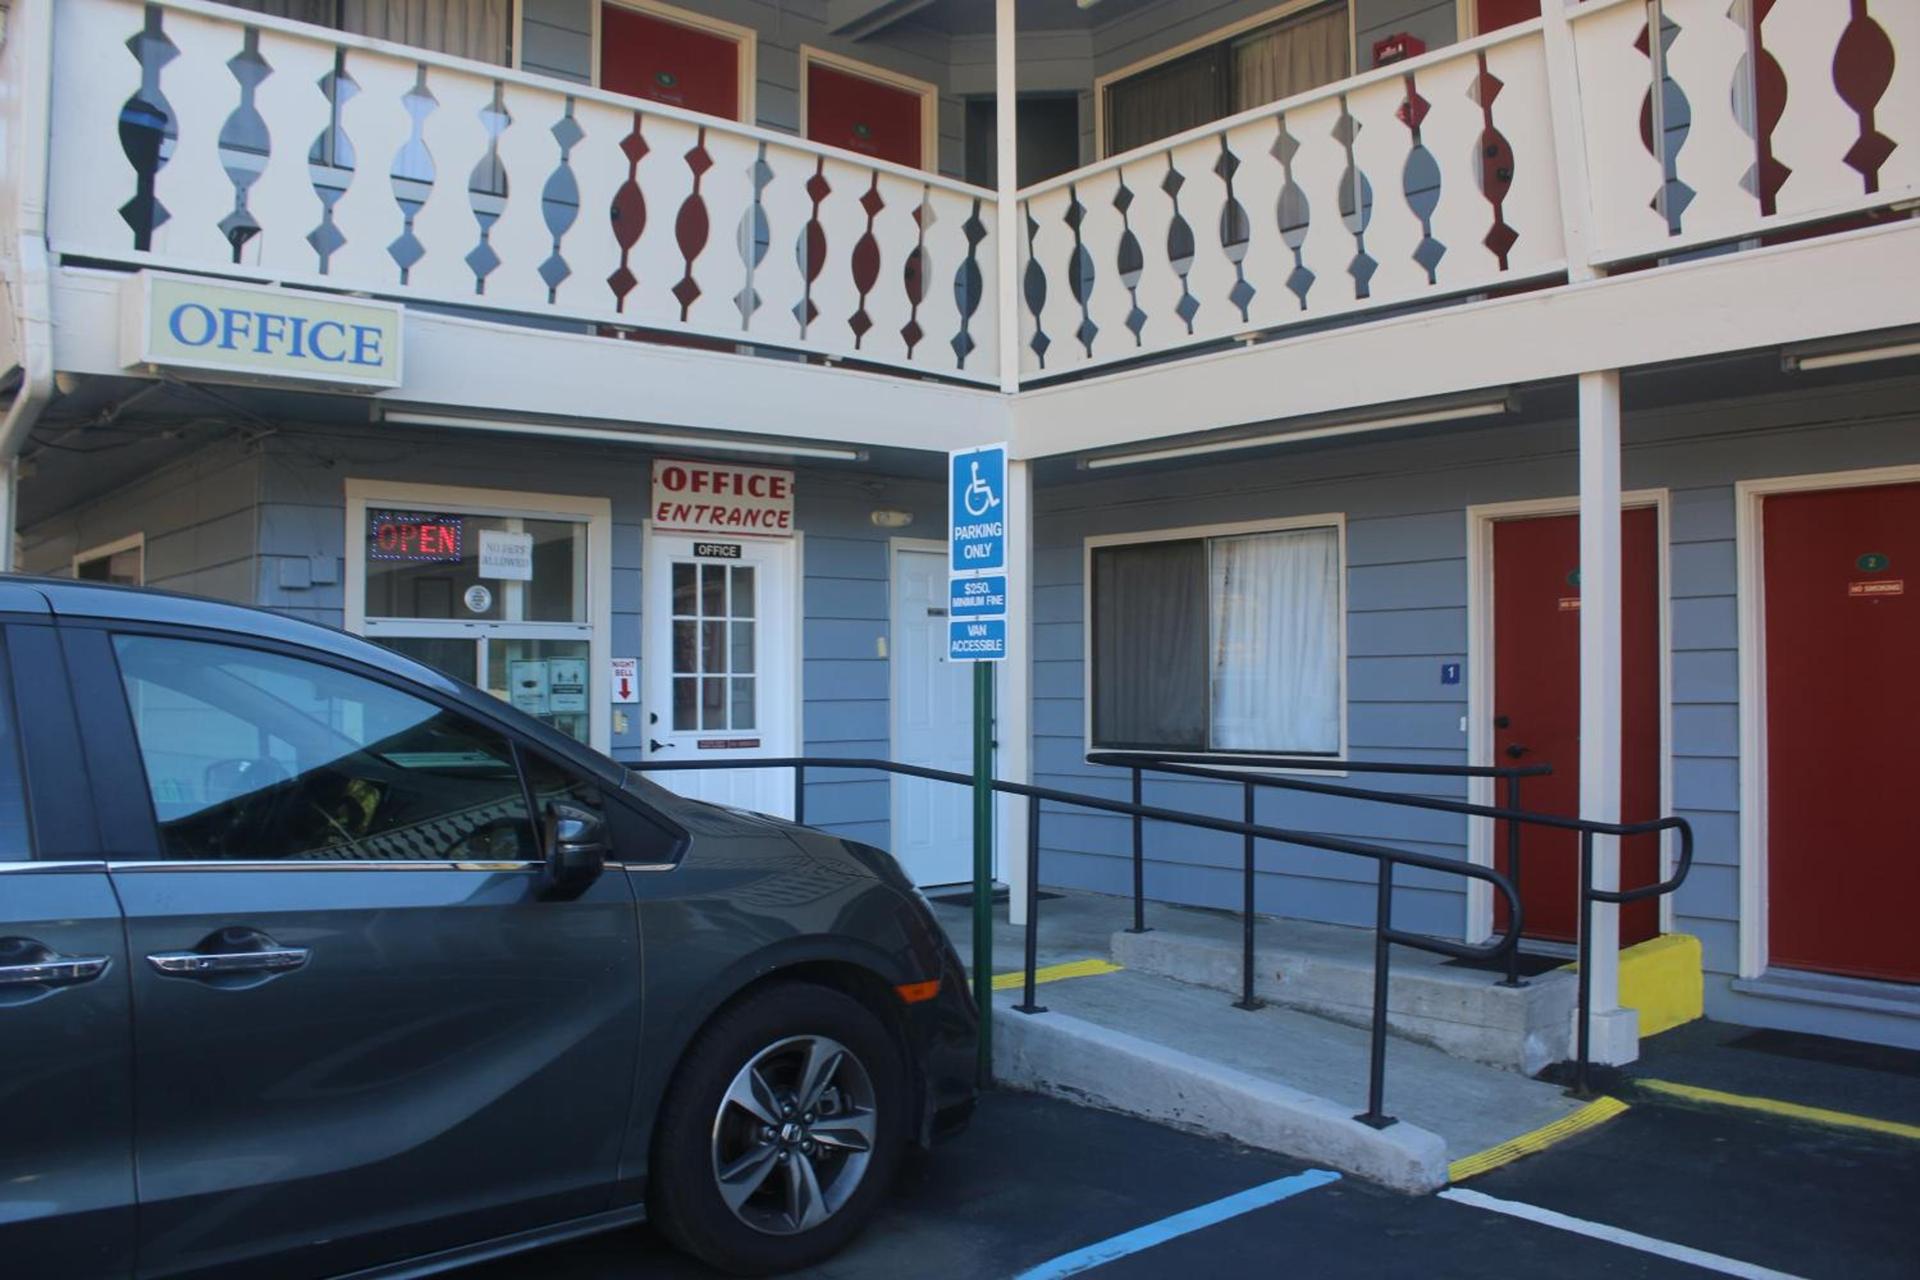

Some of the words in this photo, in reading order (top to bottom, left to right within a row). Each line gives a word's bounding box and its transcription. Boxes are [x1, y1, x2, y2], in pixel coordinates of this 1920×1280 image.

[168, 302, 384, 367] OFFICE
[661, 466, 787, 499] OFFICE
[656, 502, 791, 529] ENTRANCE
[377, 522, 457, 554] OPEN
[954, 522, 1002, 540] PARKING
[485, 543, 499, 553] NO
[698, 544, 737, 557] OFFICE
[964, 543, 993, 559] ONLY
[482, 555, 528, 568] ALLOWED
[1850, 585, 1863, 593] NO
[952, 596, 985, 608] MINIMUM
[986, 594, 1004, 606] FINE
[967, 623, 988, 638] VAN
[951, 638, 1003, 652] ACCESSIBLE
[612, 660, 634, 668] NIGHT
[1447, 666, 1455, 678] 1
